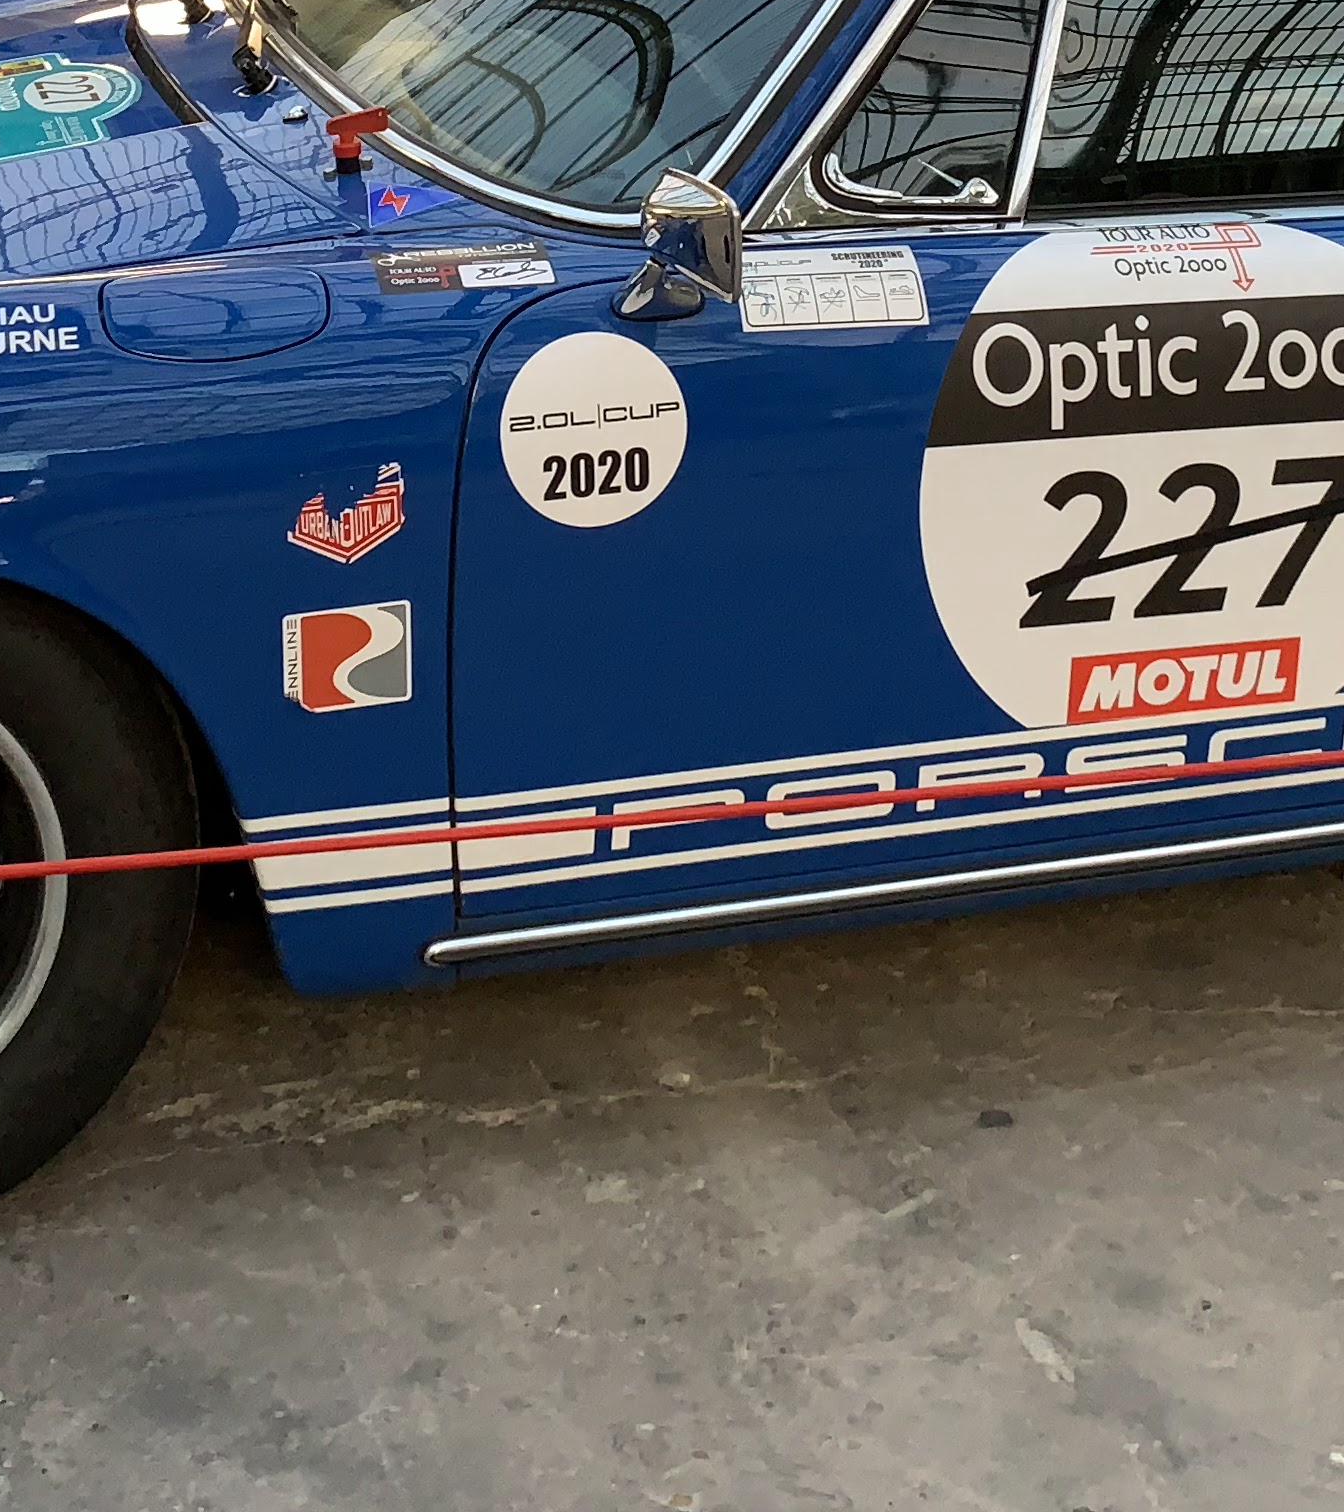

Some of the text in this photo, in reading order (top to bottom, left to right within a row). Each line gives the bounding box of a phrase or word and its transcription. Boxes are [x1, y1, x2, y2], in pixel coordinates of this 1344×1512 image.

[34, 75, 101, 105] 227
[1097, 223, 1211, 243] TOUR AUTO
[830, 250, 904, 261] SCRUTINEERING
[1136, 243, 1189, 253] 2020
[391, 276, 416, 286] Optic
[1114, 255, 1228, 282] Optic 2000
[972, 314, 1198, 431] Optic
[542, 445, 651, 502] 2020
[300, 501, 393, 548] URBAN OUTLAW
[1077, 648, 1288, 713] MOTUL
